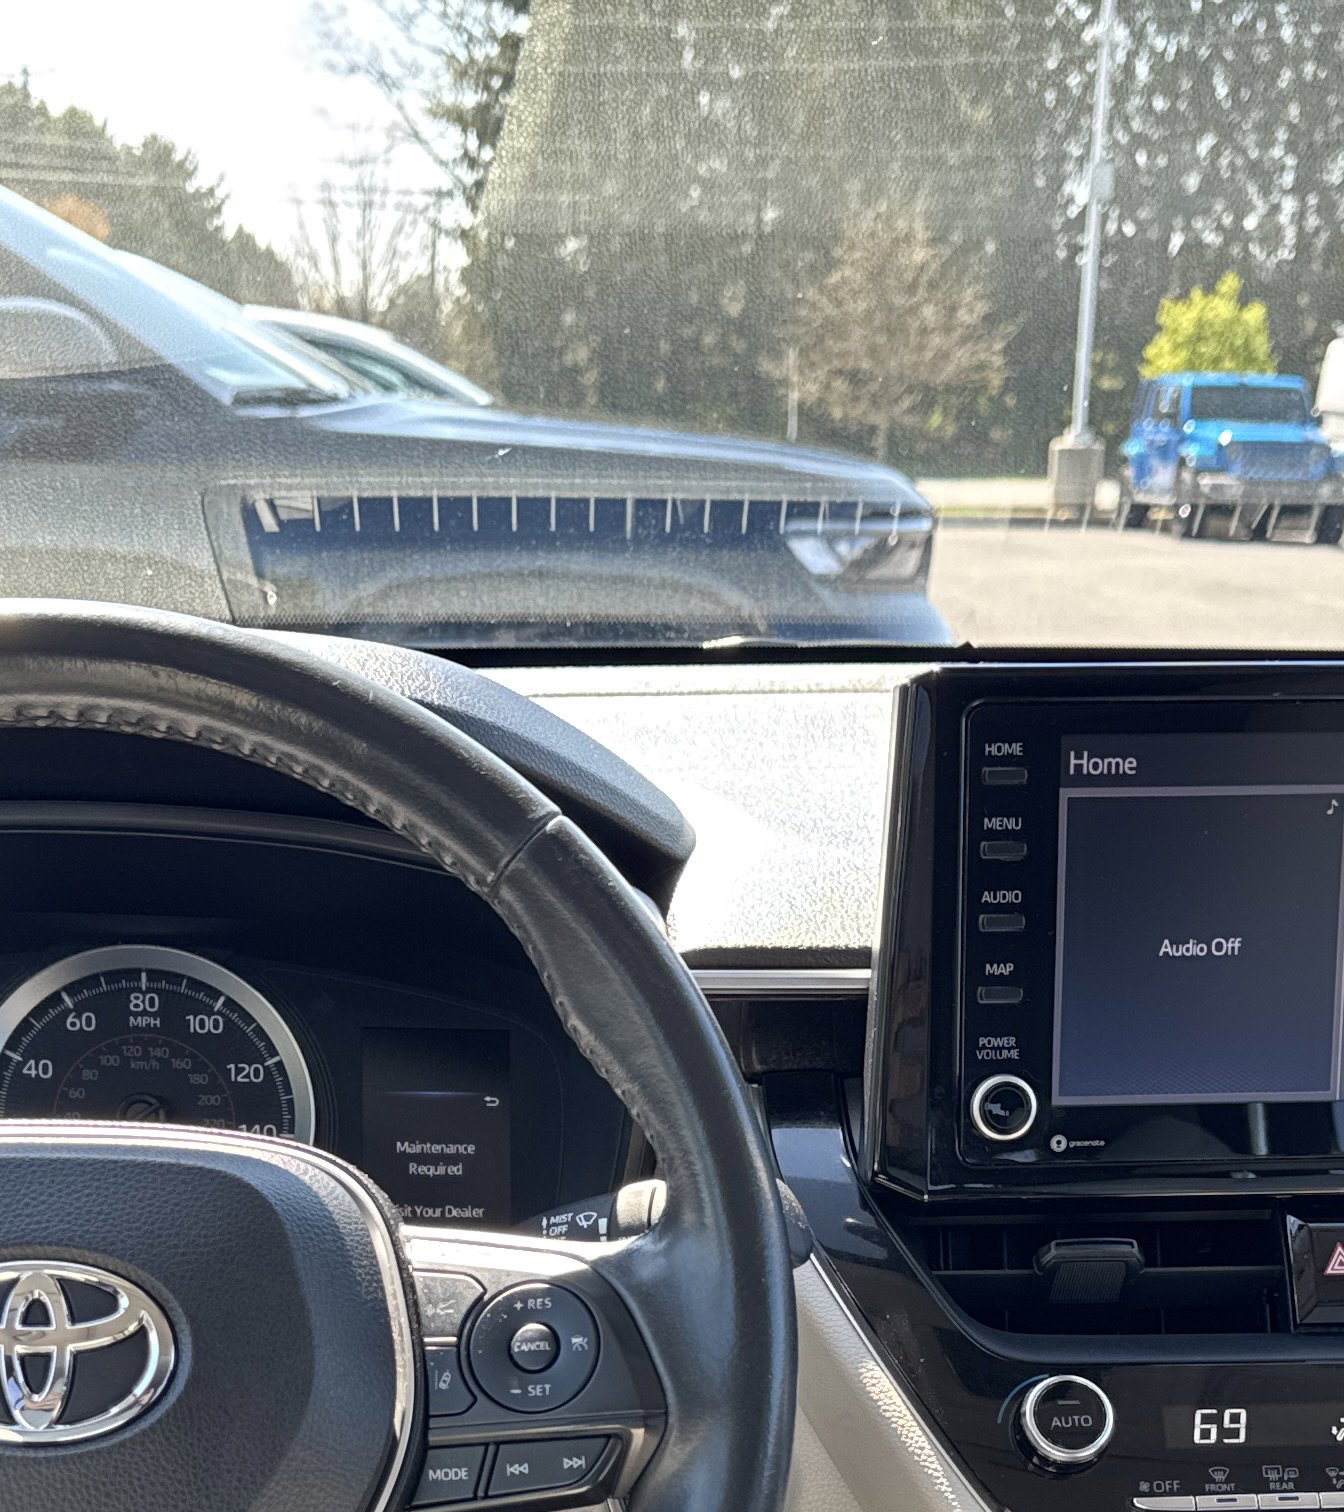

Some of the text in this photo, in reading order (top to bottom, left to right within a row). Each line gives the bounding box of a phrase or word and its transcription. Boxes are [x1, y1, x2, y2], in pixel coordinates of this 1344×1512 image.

[984, 742, 1024, 756] HOME
[1069, 750, 1137, 776] Home
[983, 817, 1022, 831] MENU
[981, 890, 1022, 904] AUDIO
[1158, 936, 1243, 957] Audio Off
[985, 963, 1014, 976] MAP
[128, 993, 160, 1012] 80
[65, 1012, 96, 1031] 60
[129, 1016, 161, 1029] MPH
[185, 1014, 224, 1034] 100
[978, 1036, 1017, 1048] POWER
[976, 1048, 1021, 1060] VOLUME
[22, 1059, 53, 1079] 40
[226, 1063, 265, 1083] 120
[396, 1141, 476, 1155] Maintenance
[408, 1162, 463, 1177] Required
[414, 1205, 443, 1218] Your
[444, 1204, 485, 1218] Dealer
[549, 1212, 574, 1225] MIST
[548, 1224, 569, 1236] OFF
[527, 1298, 552, 1310] RES
[513, 1341, 551, 1353] CANCEL
[527, 1384, 552, 1397] SET
[1050, 1414, 1093, 1430] AUTO
[1193, 1408, 1247, 1444] 69
[428, 1467, 469, 1481] MODE
[1152, 1480, 1182, 1493] OFF
[1205, 1483, 1236, 1492] FRONT
[1269, 1481, 1296, 1491] REAR
